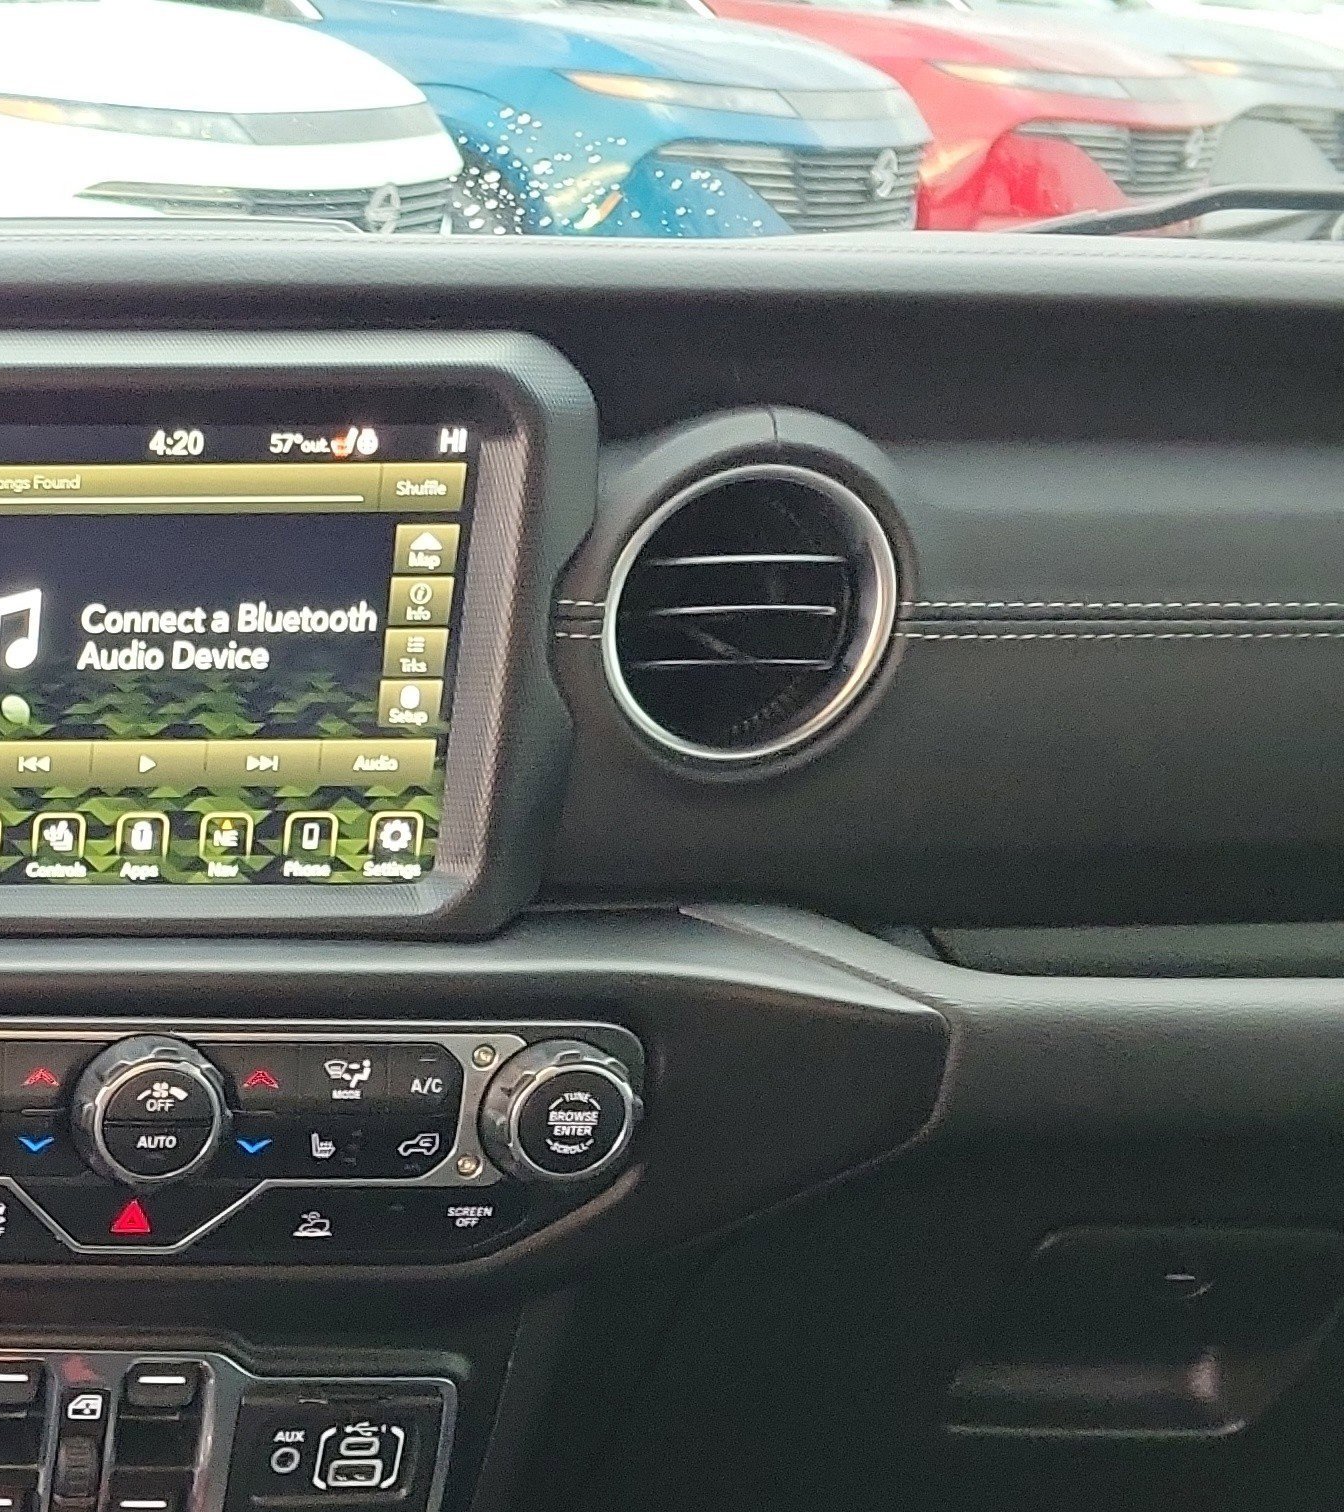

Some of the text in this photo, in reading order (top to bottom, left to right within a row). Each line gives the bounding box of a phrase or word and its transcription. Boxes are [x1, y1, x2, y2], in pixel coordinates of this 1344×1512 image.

[149, 429, 204, 456] 4:20
[440, 428, 466, 454] HI
[33, 474, 81, 490] Found
[395, 479, 447, 496] Shuffle
[408, 552, 441, 569] Map
[81, 601, 378, 633] Connect a Bluetooth
[406, 606, 431, 621] Info
[77, 639, 270, 670] Audio Device
[388, 708, 428, 725] Setup
[353, 755, 399, 771] Audio
[26, 861, 87, 878] Controls
[119, 861, 159, 881] Apps
[208, 861, 239, 877] Nav
[283, 861, 332, 877] Phone
[363, 860, 422, 881] Settings
[332, 1089, 361, 1099] MODE
[411, 1078, 443, 1094] A/C
[563, 1092, 589, 1104] TUNE
[145, 1100, 174, 1113] OFF
[548, 1110, 599, 1123] BROWSE
[553, 1124, 593, 1137] ENTER
[136, 1135, 177, 1149] AUTO
[447, 1206, 493, 1217] SCREEN
[455, 1217, 480, 1228] OFF
[273, 1430, 305, 1443] AUX
